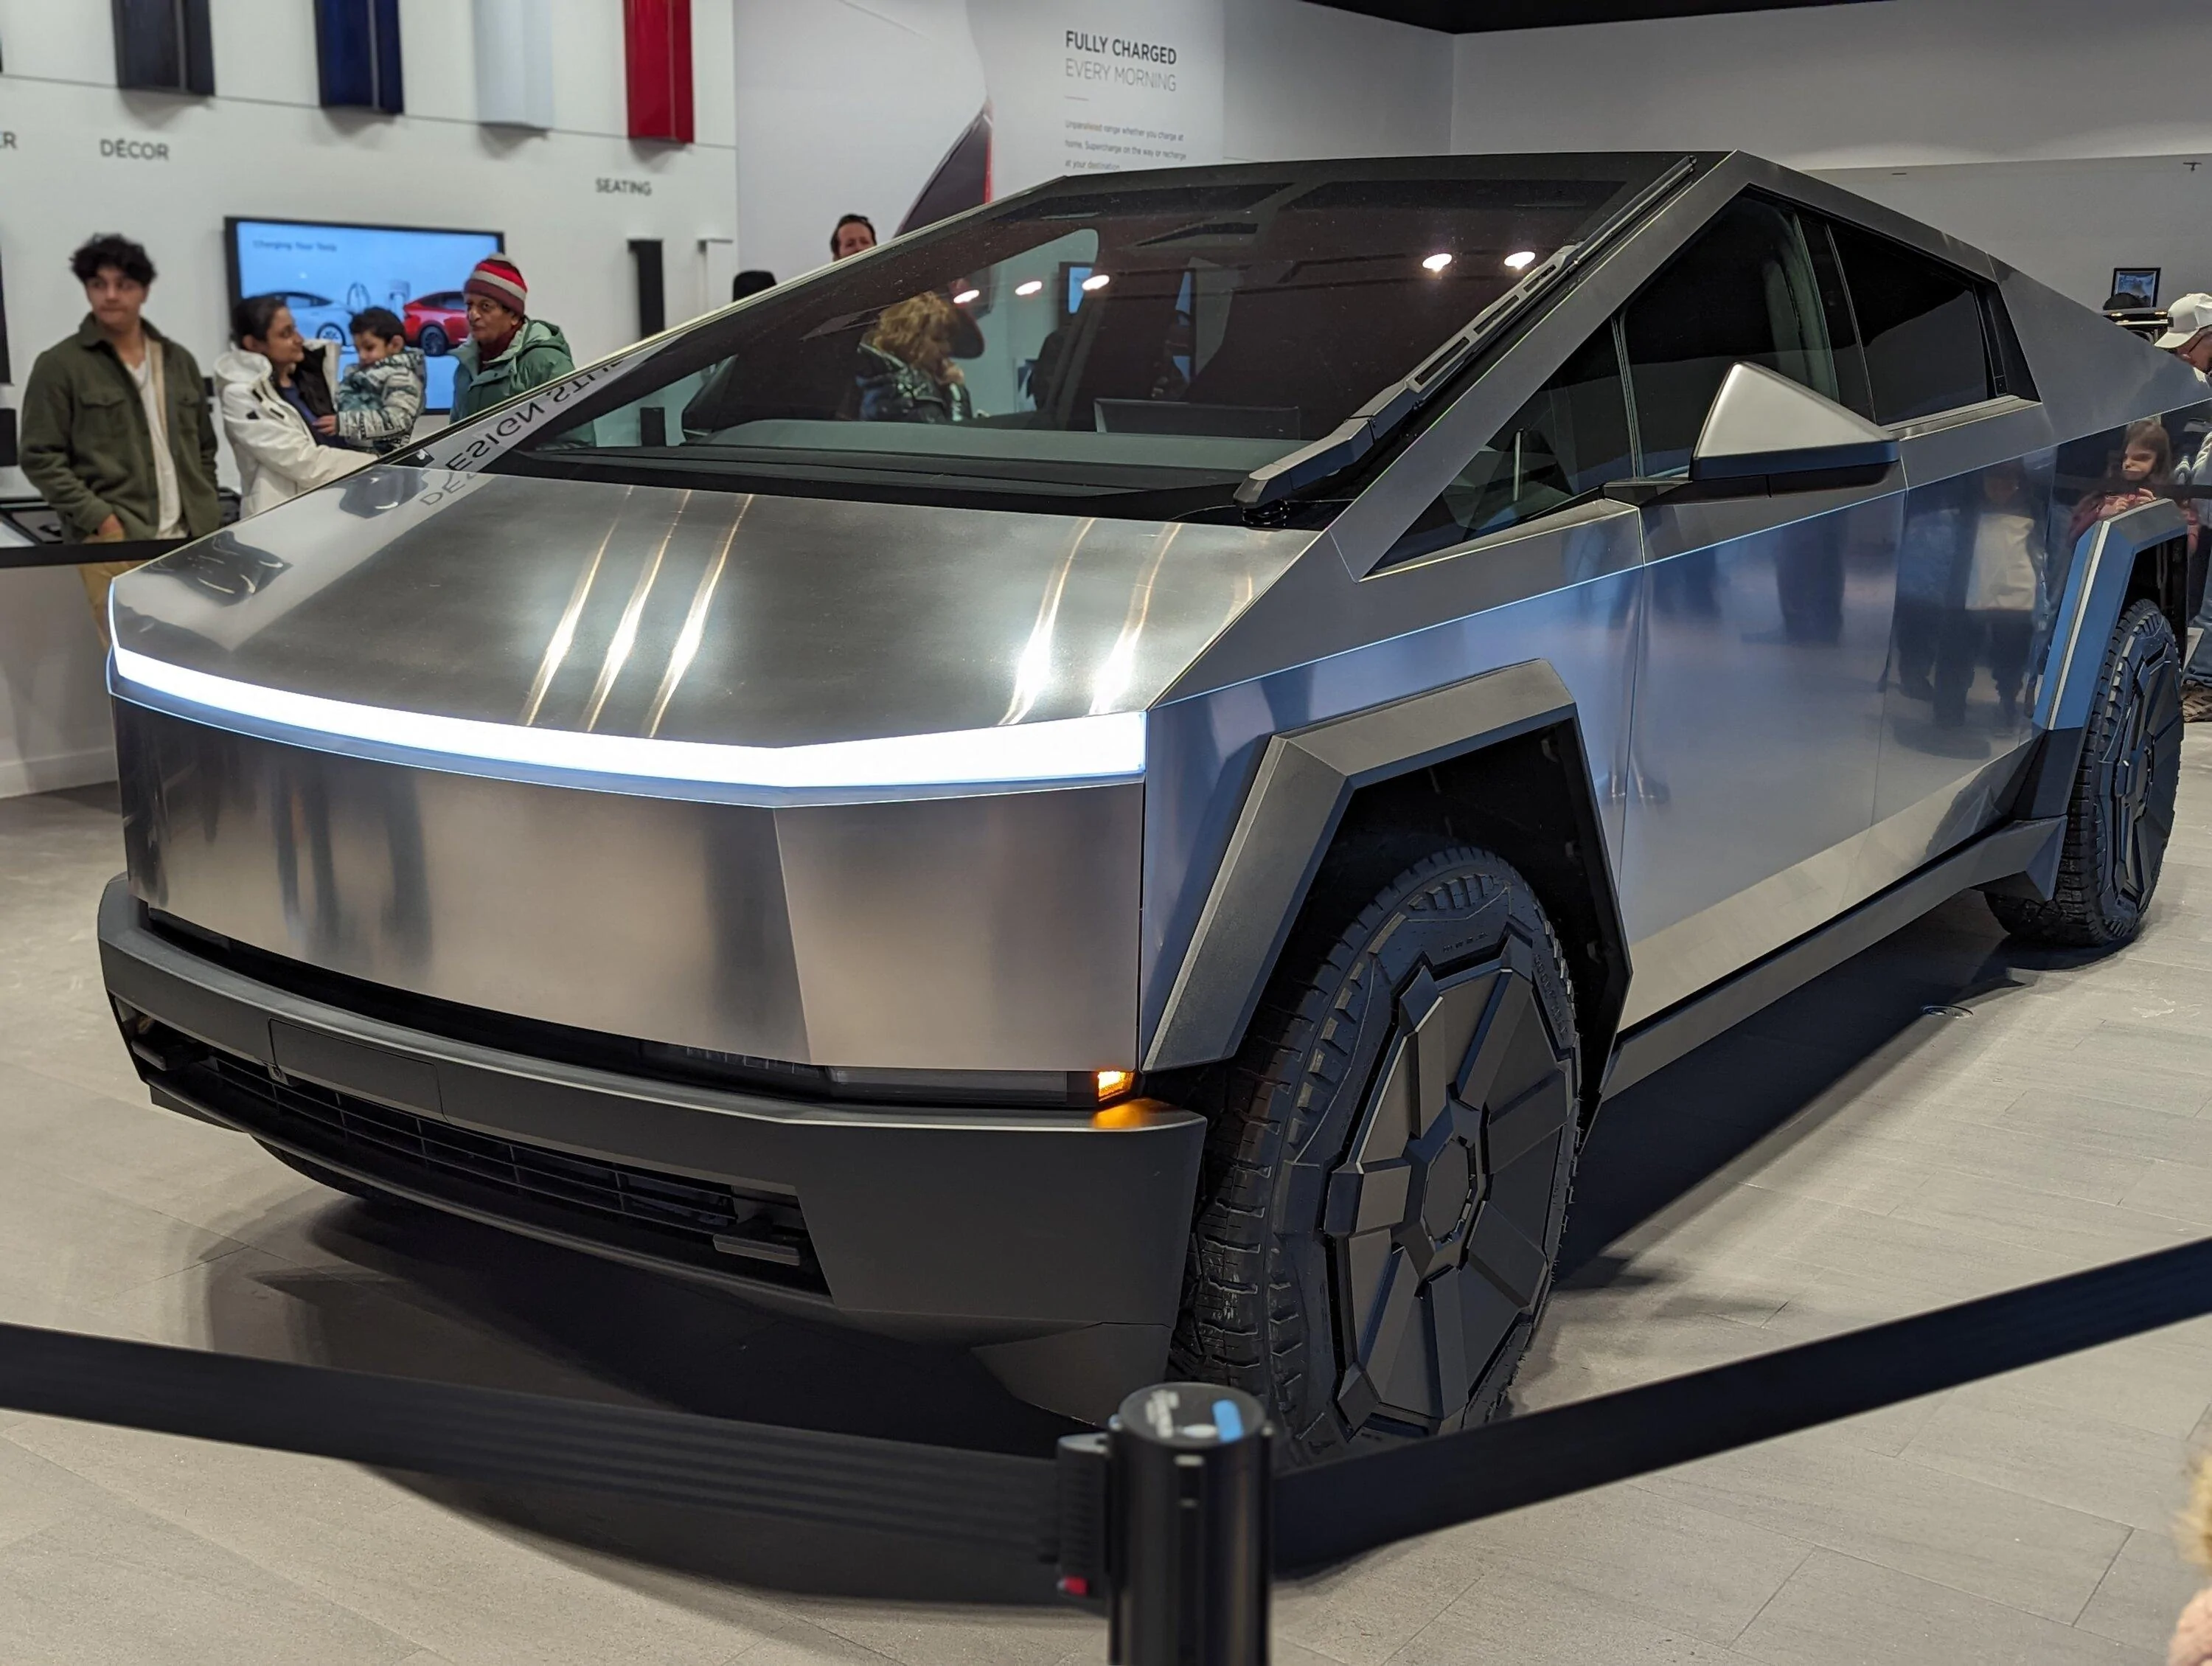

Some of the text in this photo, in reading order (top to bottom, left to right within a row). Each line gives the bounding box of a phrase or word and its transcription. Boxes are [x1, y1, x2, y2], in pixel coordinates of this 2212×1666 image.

[1065, 30, 1178, 65] FULLY CHARGED
[1065, 58, 1178, 92] EVERY MORNING
[1122, 128, 1144, 136] whether
[1146, 131, 1157, 139] you
[1158, 131, 1176, 142] charge
[100, 138, 170, 160] DÉCOR
[1131, 147, 1141, 155] the
[1143, 149, 1154, 158] way
[1162, 150, 1186, 162] recharge
[1072, 161, 1086, 169] your
[595, 177, 653, 197] SEATING
